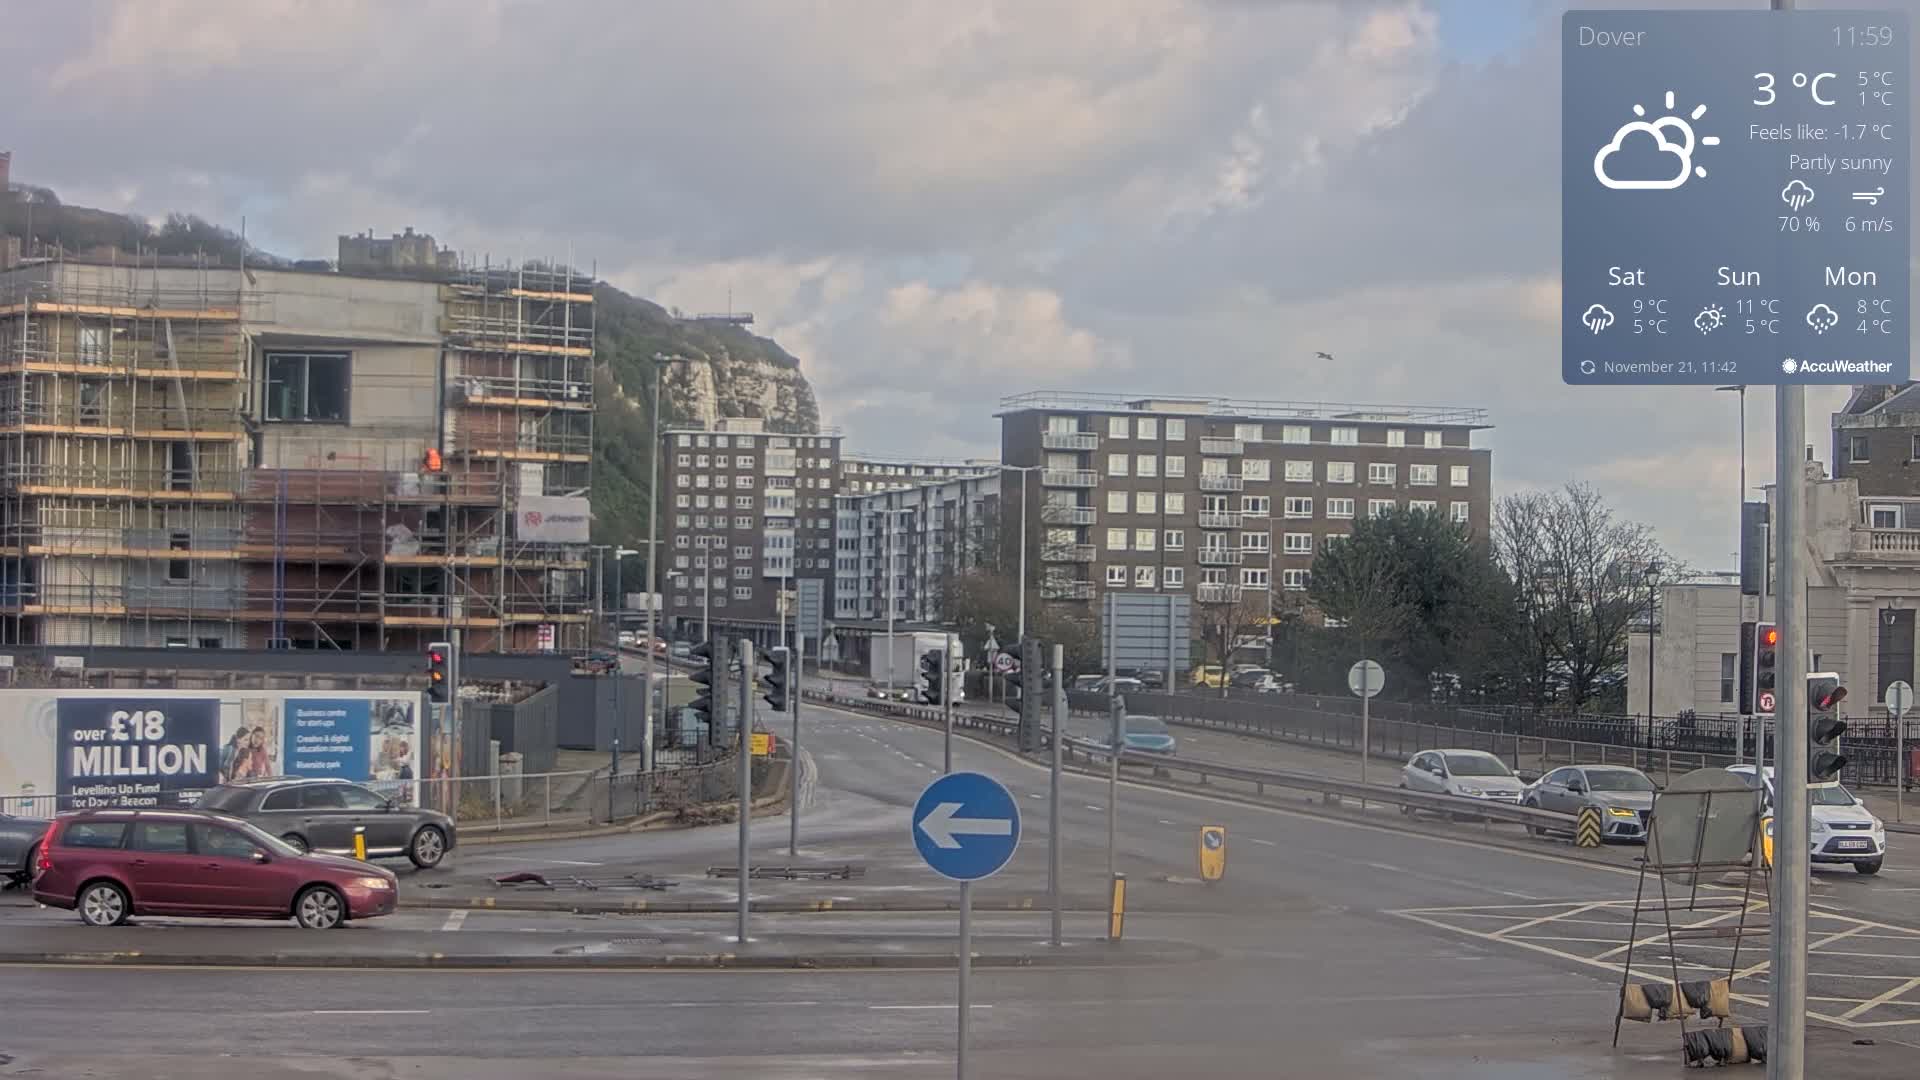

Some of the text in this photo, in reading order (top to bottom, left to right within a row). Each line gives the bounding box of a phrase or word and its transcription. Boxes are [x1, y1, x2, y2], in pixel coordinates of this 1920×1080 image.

[998, 656, 1011, 666] 40
[73, 710, 165, 741] over £18
[73, 744, 207, 776] MILLION
[135, 783, 160, 794] Fund
[121, 796, 158, 806] Beacon
